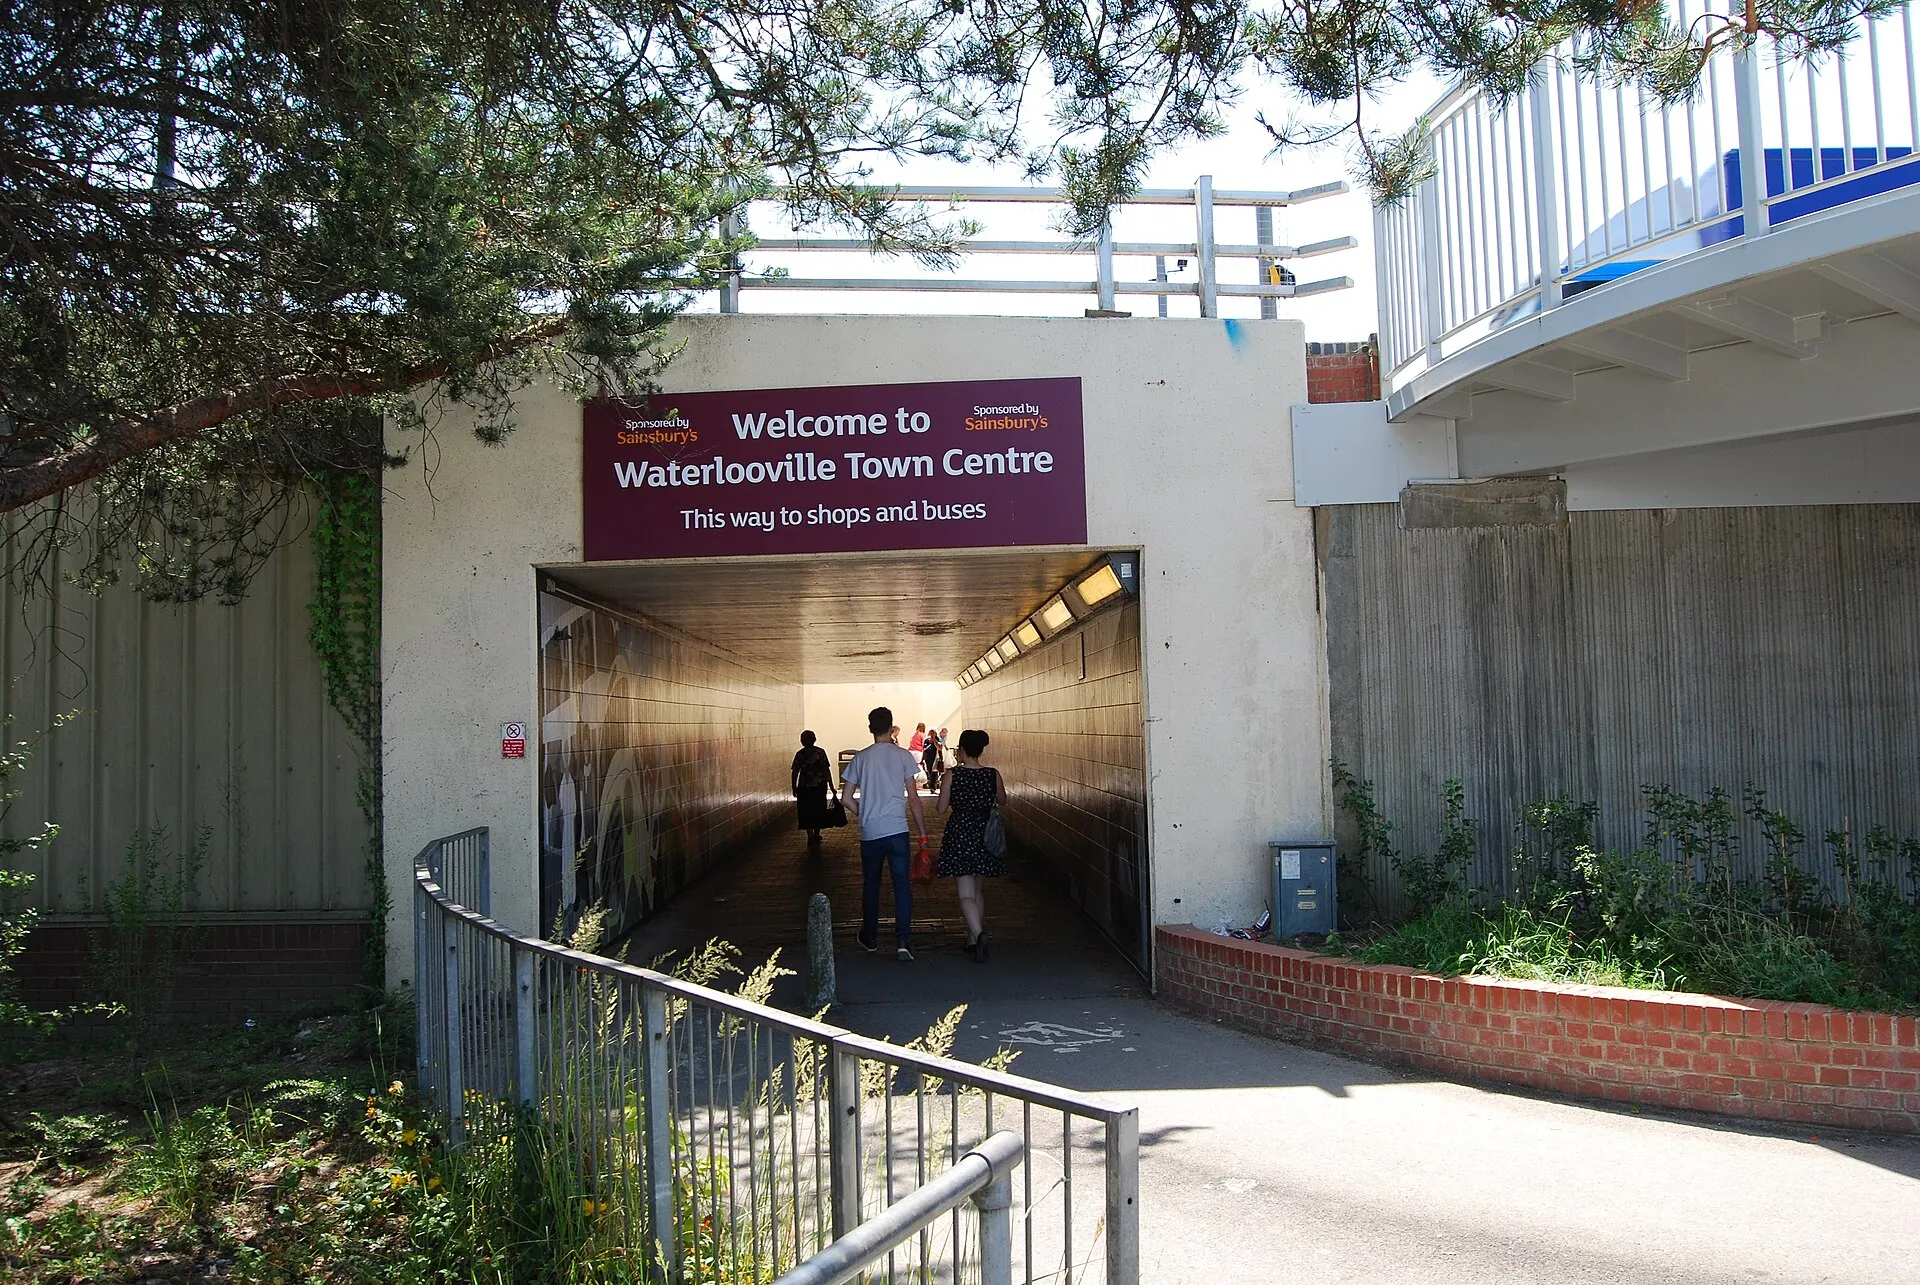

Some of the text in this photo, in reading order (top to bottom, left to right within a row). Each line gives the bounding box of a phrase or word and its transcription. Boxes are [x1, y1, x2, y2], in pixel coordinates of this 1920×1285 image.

[973, 403, 1039, 417] Sponsored by
[625, 415, 690, 431] Sponsored by
[731, 407, 931, 440] Welcome to
[965, 415, 1049, 432] Sainsbury's
[616, 428, 699, 445] Sainsbury's
[613, 446, 1054, 488] Waterlooville Town Centre
[680, 499, 987, 532] This way to shops and buses
